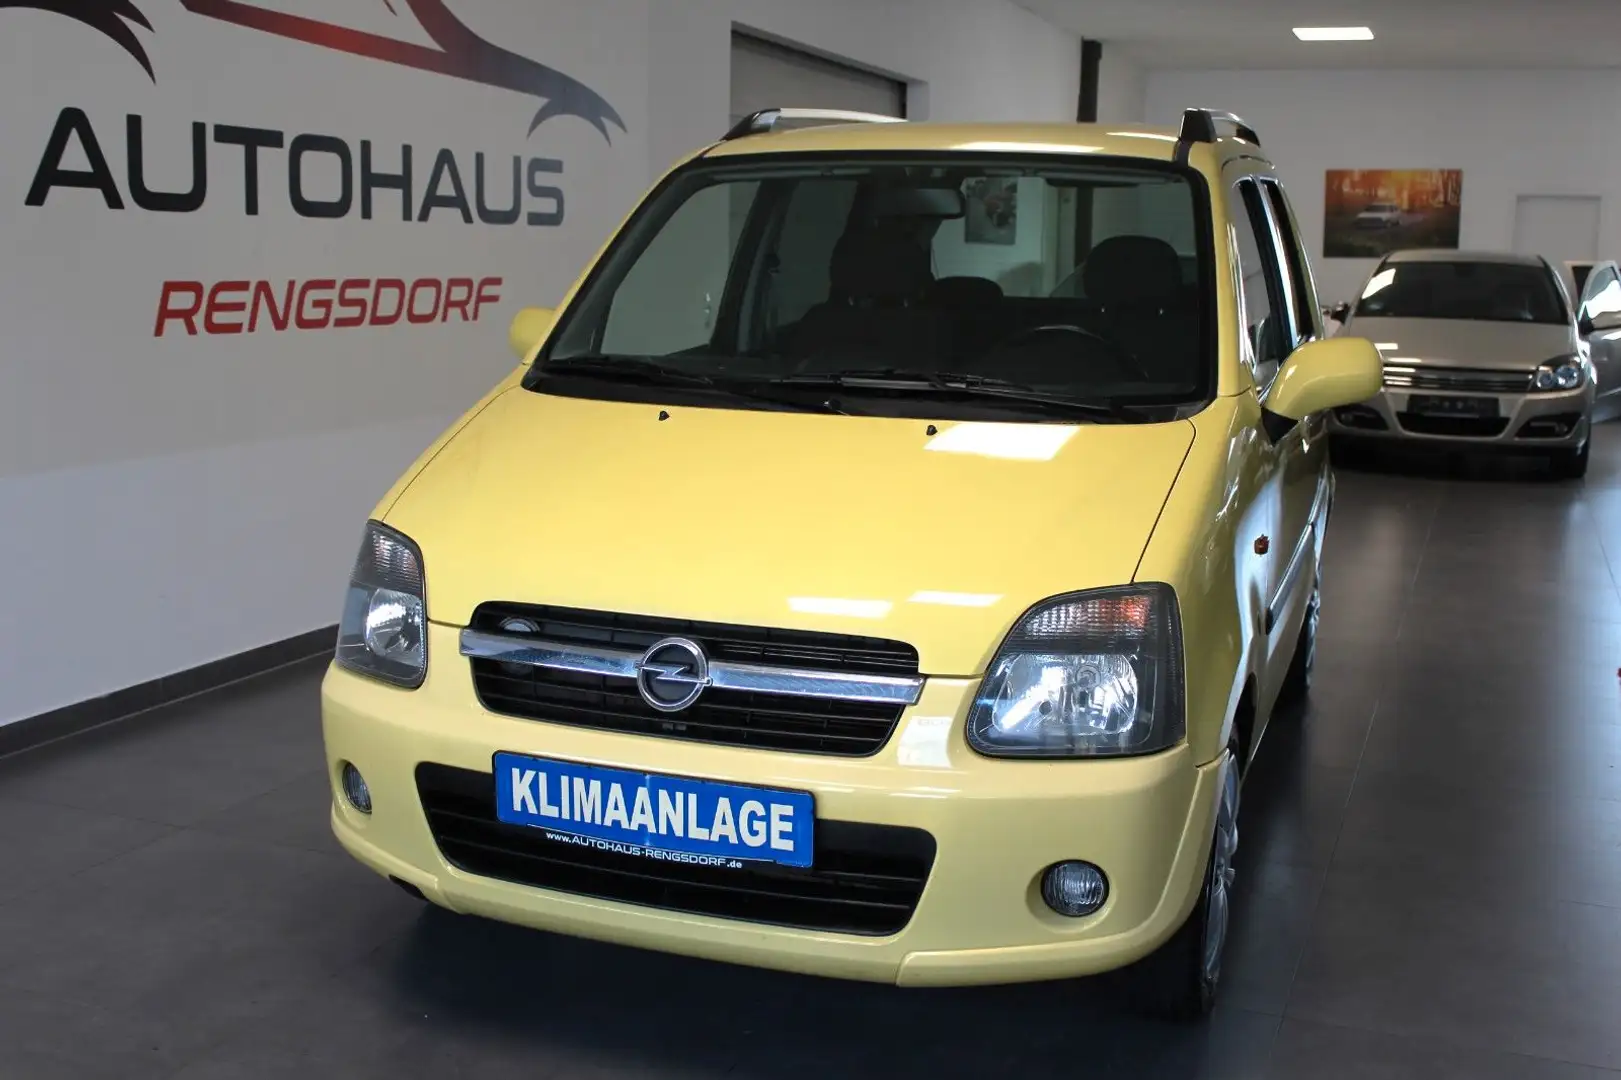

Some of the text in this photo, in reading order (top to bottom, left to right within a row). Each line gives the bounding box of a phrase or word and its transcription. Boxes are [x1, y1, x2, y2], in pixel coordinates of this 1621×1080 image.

[24, 107, 564, 226] AUTOHAUS
[154, 277, 502, 337] RENGSDORF
[511, 767, 794, 851] KLIMAANLAGE
[546, 832, 743, 869] www.AUTOHAUS-RENGSDORF.de
